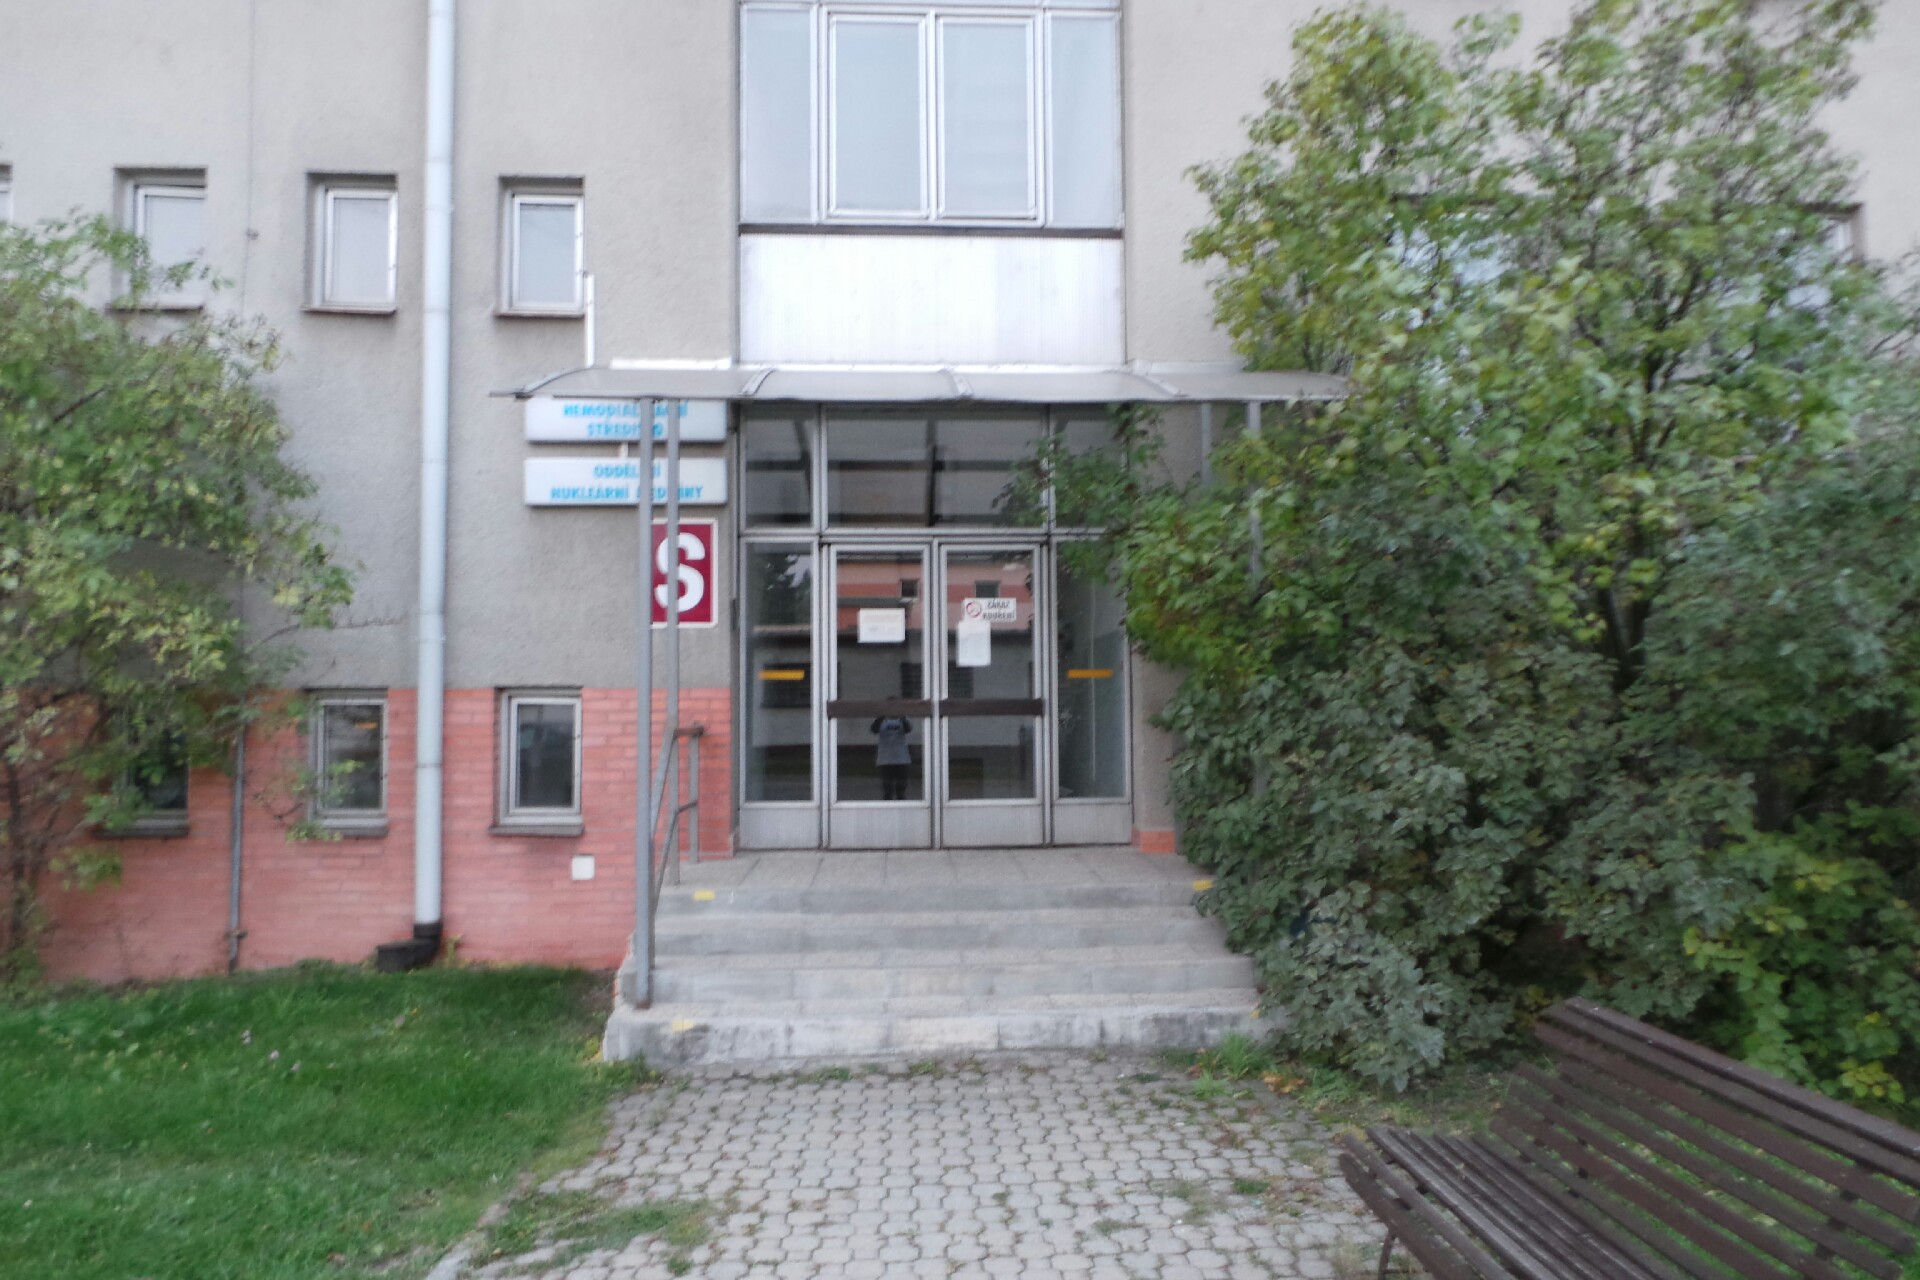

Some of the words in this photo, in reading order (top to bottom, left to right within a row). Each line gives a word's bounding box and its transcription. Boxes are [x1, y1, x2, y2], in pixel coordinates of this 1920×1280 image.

[588, 419, 663, 437] STŘEDIO
[593, 463, 660, 478] ODDĚLÍ
[551, 483, 629, 499] NUKLEÁRNÍ
[654, 532, 706, 613] S
